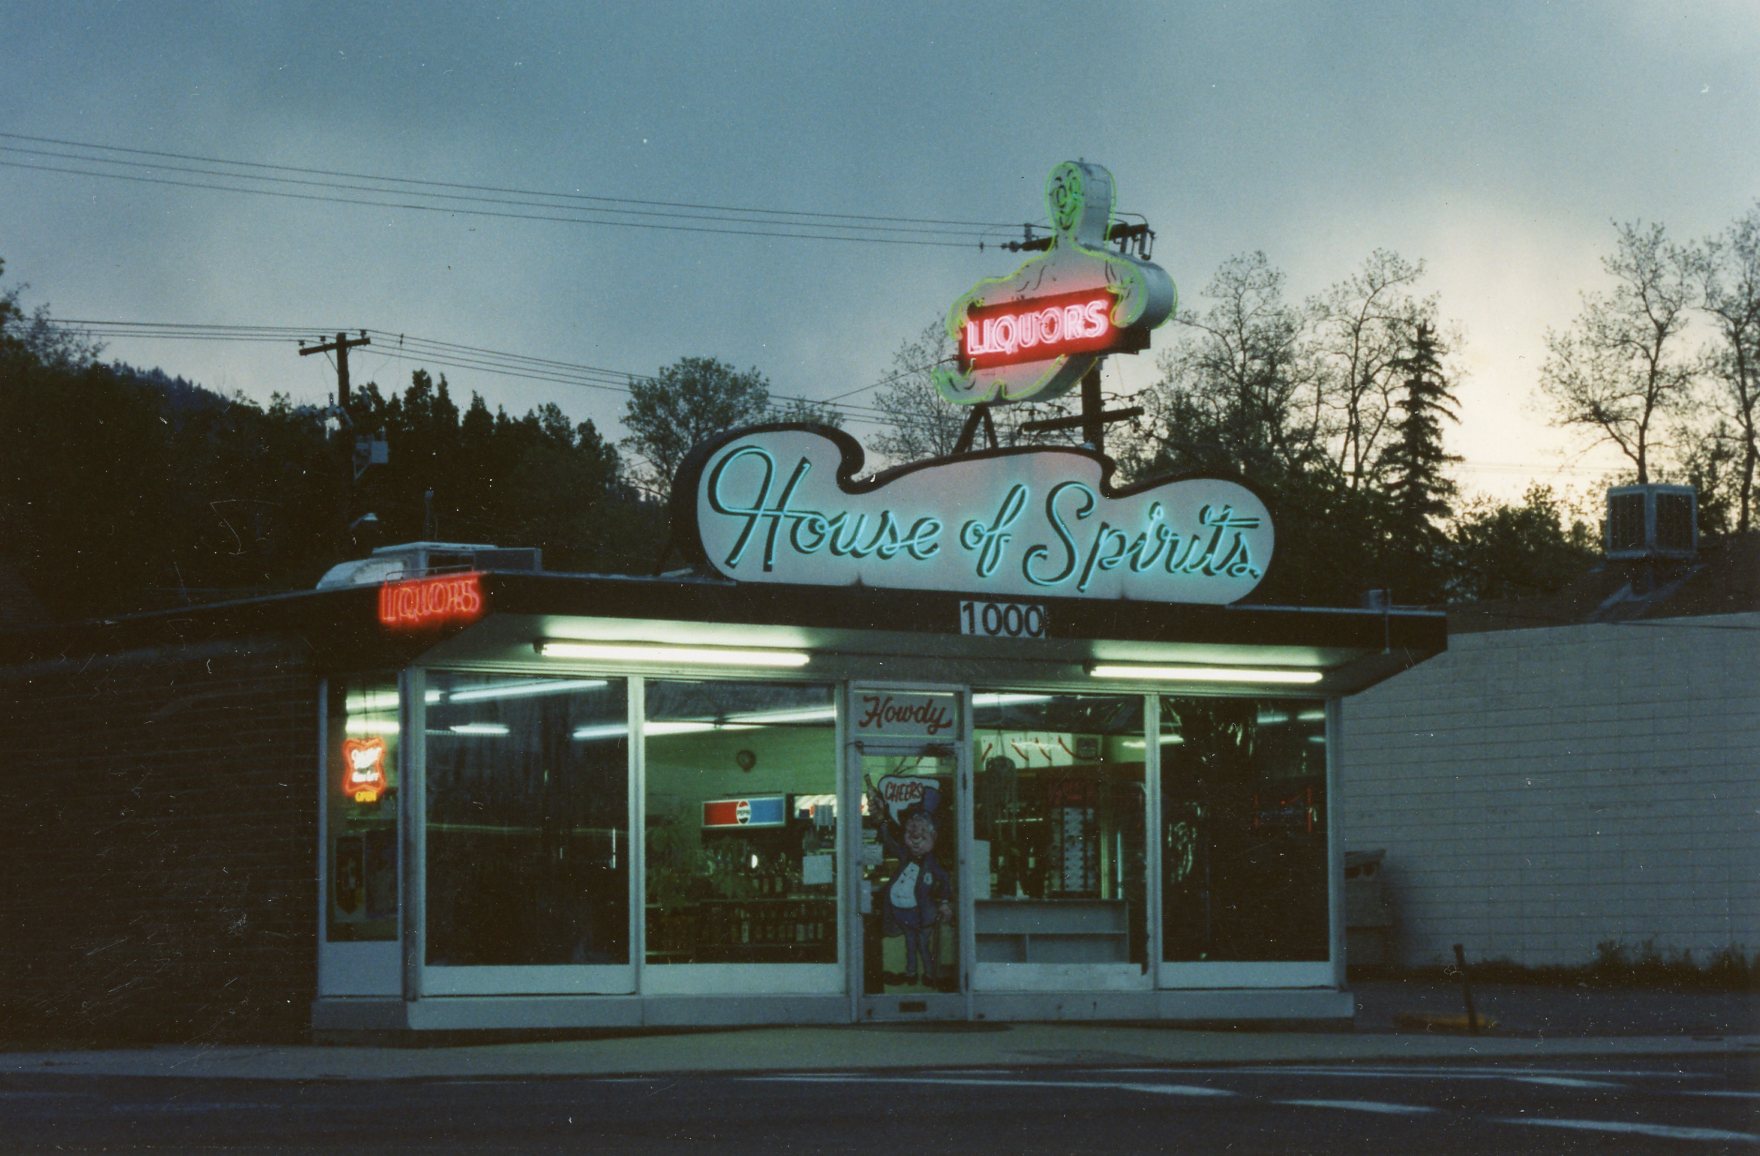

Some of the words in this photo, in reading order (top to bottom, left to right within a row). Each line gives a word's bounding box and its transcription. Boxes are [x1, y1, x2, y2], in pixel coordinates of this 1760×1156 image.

[966, 301, 1109, 355] LIQUORS
[707, 446, 941, 572] House
[959, 482, 1026, 577] of
[1022, 481, 1260, 592] Spirits
[381, 580, 480, 621] LIQUORS
[962, 602, 1044, 637] 1000
[858, 696, 953, 735] Howdy
[885, 782, 923, 802] CHEERS
